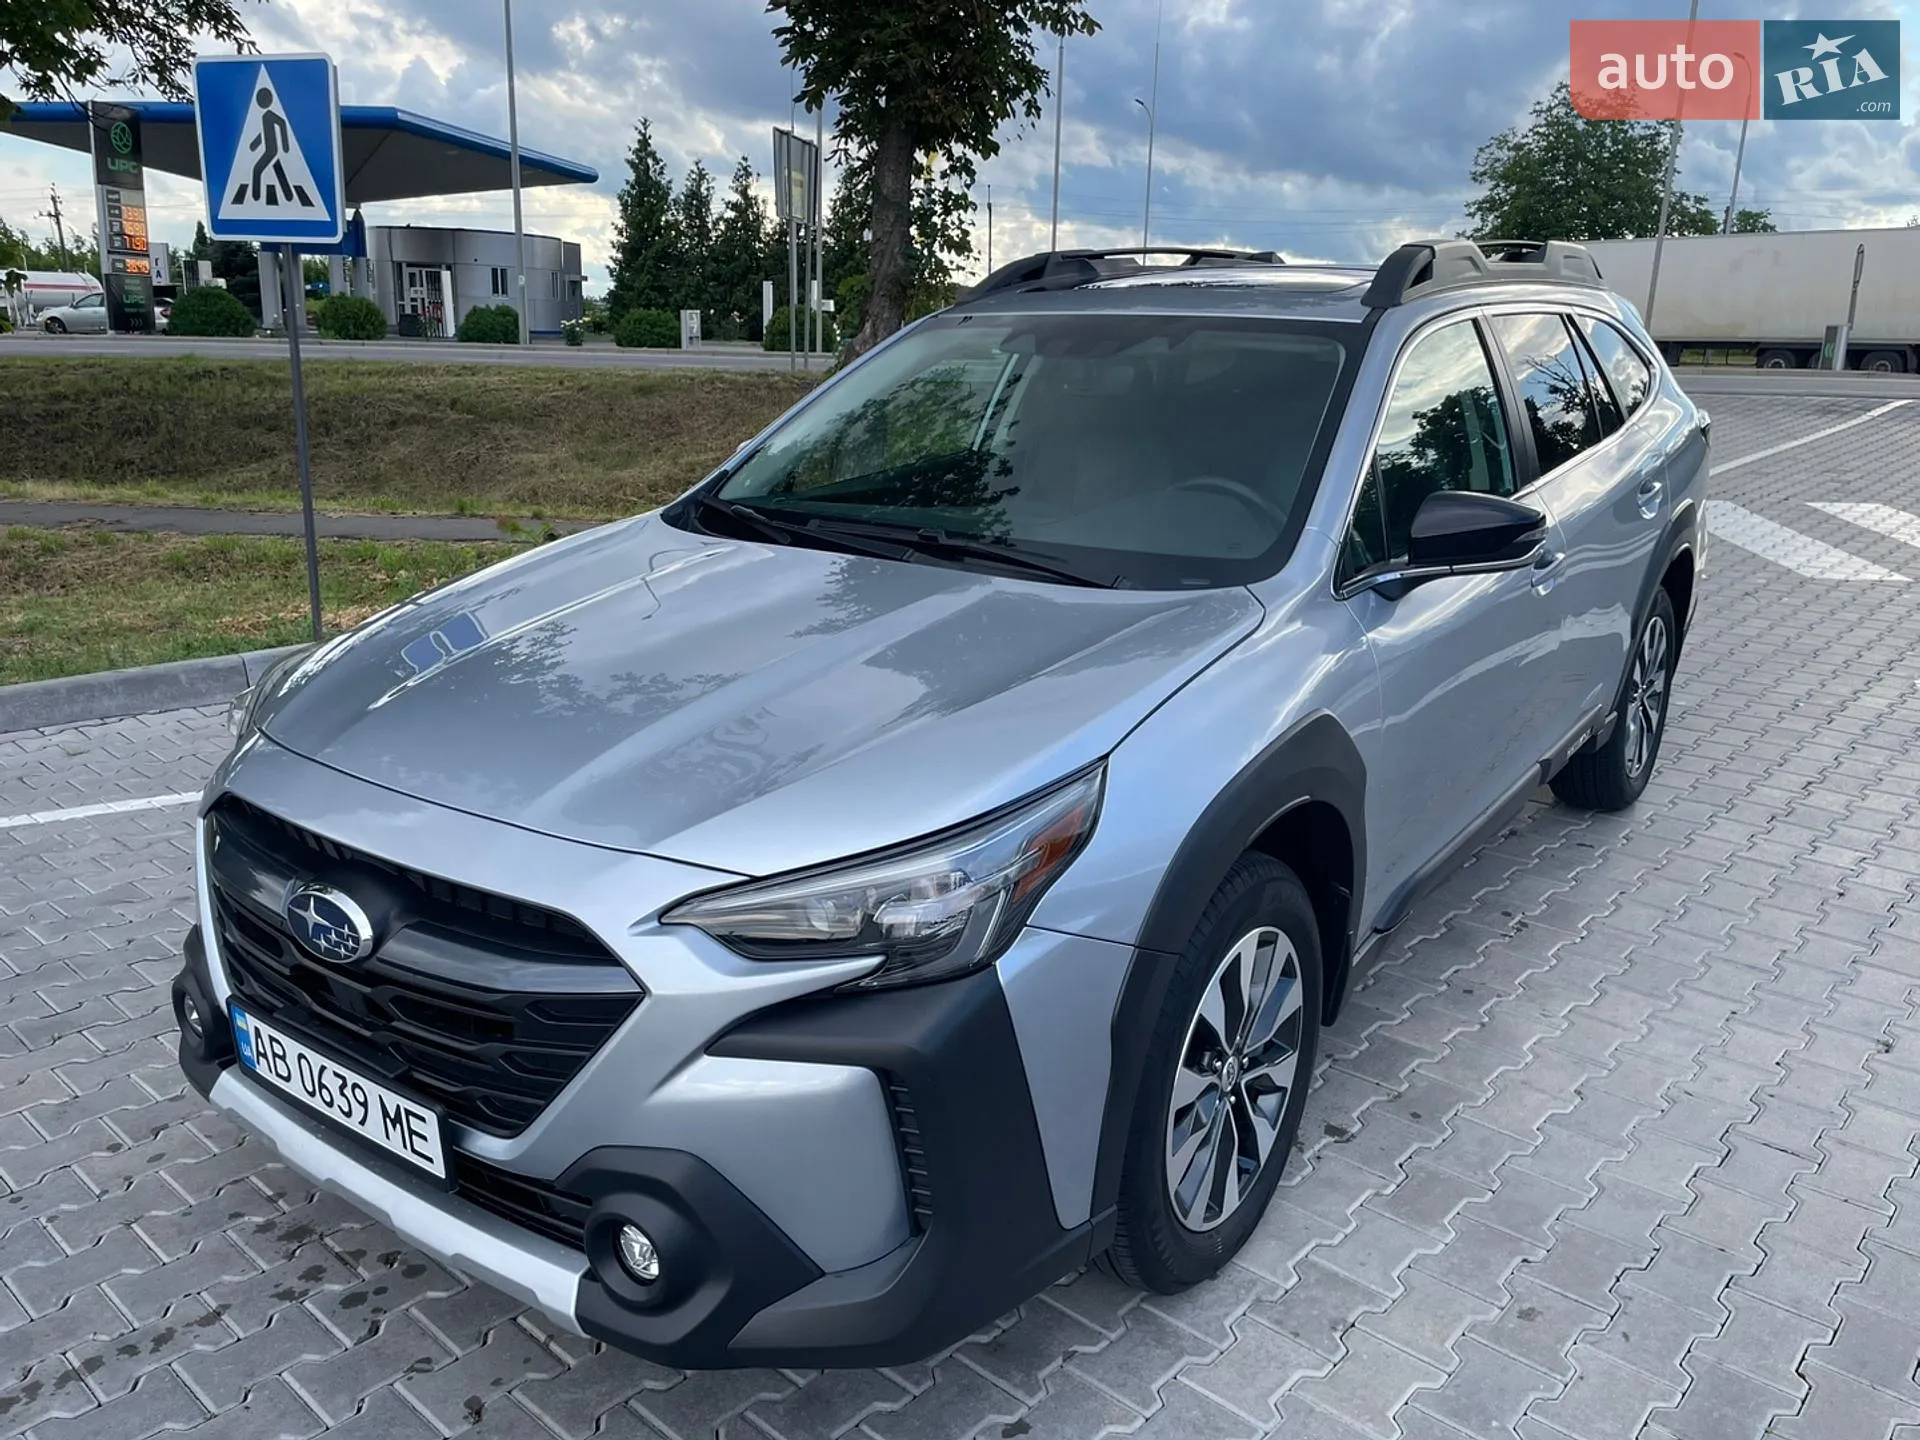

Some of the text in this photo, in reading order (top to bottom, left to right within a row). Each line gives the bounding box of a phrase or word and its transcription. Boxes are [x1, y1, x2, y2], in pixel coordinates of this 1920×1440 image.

[107, 157, 138, 173] UPC
[254, 1025, 435, 1165] AB 0639 ME
